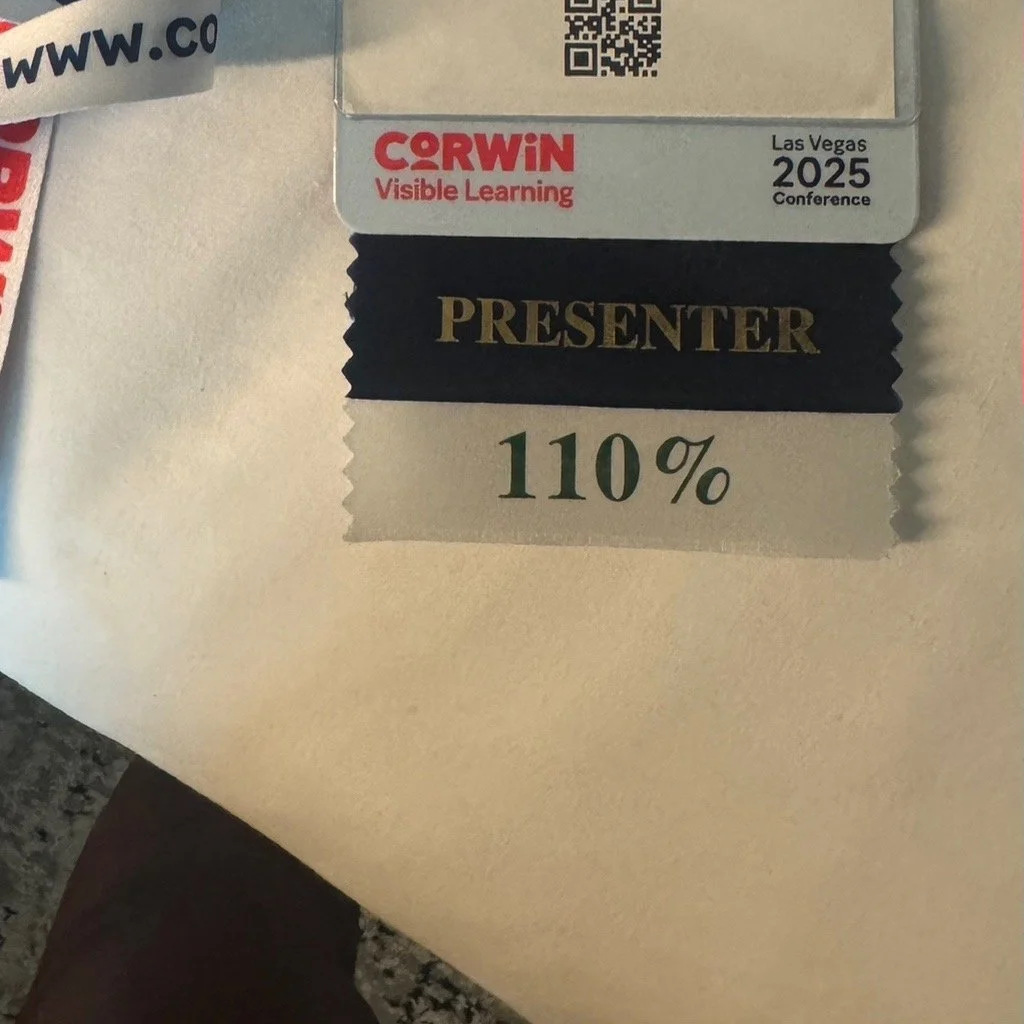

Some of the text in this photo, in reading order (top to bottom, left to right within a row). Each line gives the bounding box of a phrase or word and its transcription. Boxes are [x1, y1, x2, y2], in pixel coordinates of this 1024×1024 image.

[772, 135, 867, 155] Las Vegas
[772, 156, 871, 189] 2025
[375, 178, 574, 208] Visible Learning
[772, 191, 871, 207] Conference
[435, 296, 821, 354] PRESENTER
[497, 431, 731, 505] 110%
